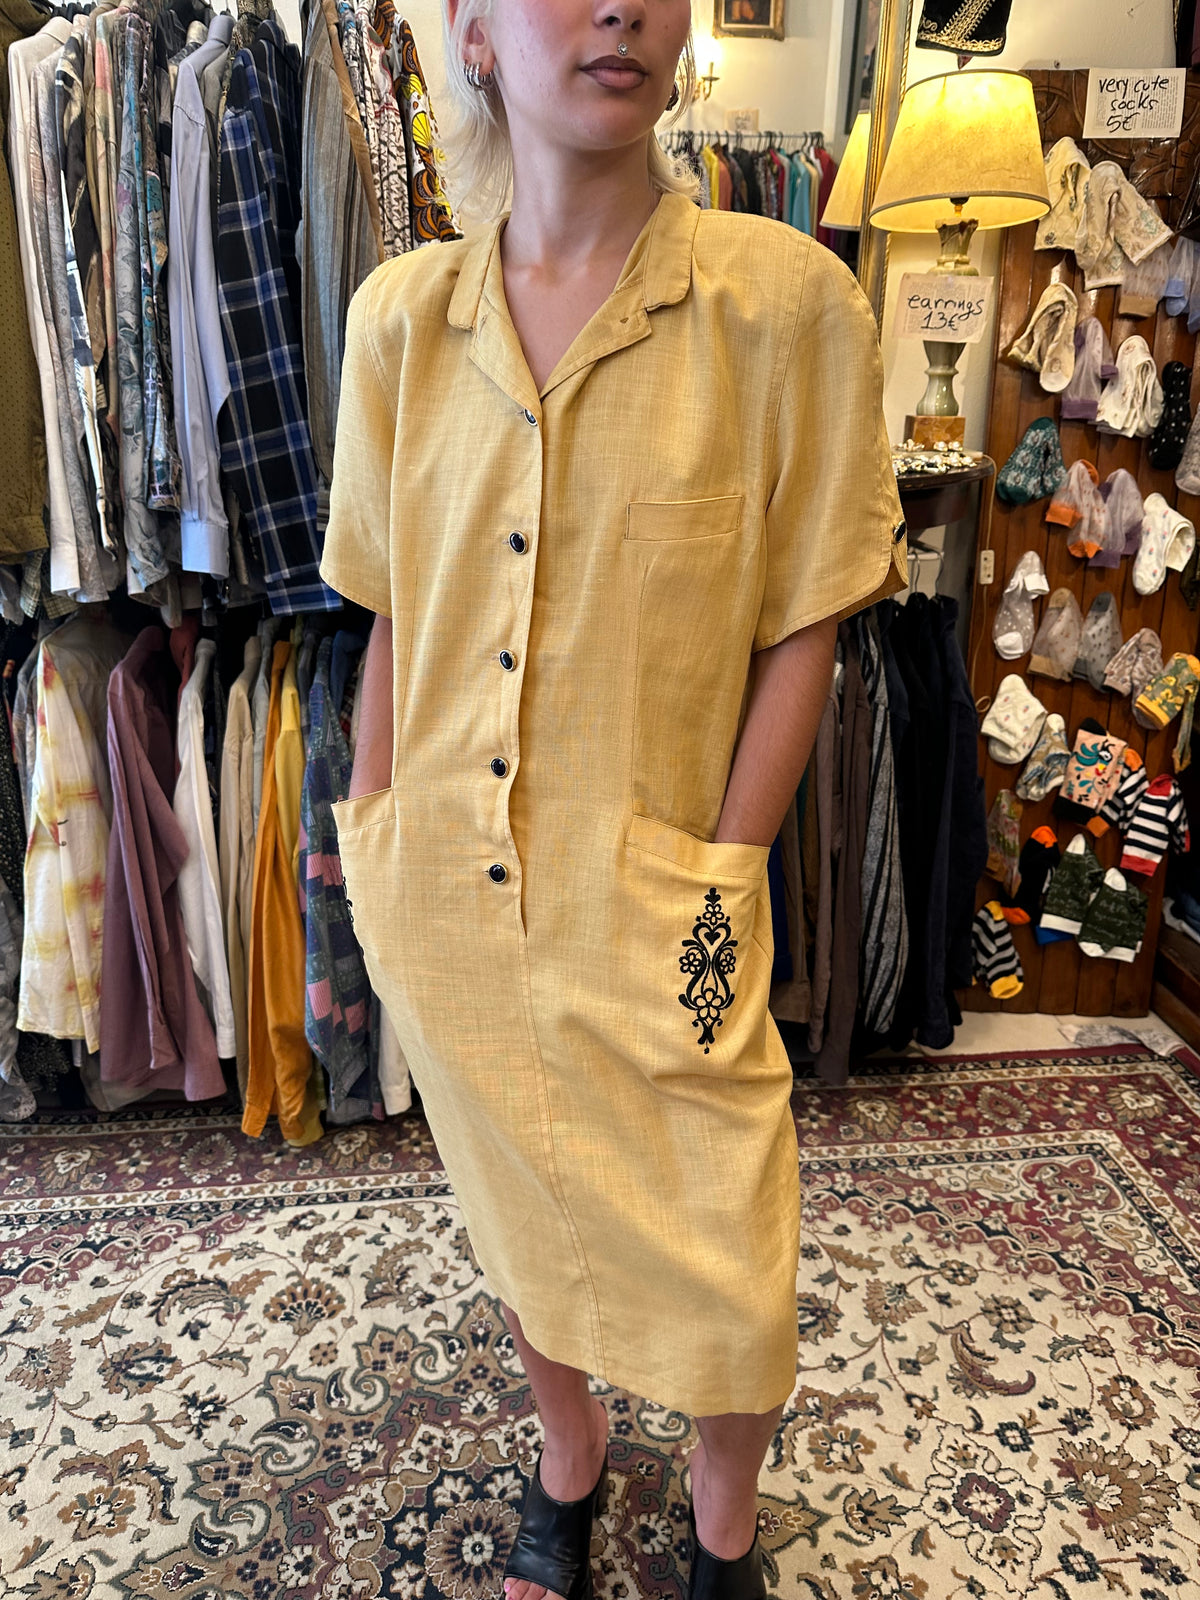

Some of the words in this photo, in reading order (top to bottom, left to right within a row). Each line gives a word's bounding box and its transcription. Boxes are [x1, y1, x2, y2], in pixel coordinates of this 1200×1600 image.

[1099, 78, 1129, 99] very
[1134, 75, 1169, 92] cute
[1111, 92, 1159, 111] socks
[1106, 112, 1140, 133] 5€
[907, 294, 985, 321] earrings
[920, 311, 959, 331] 13€
